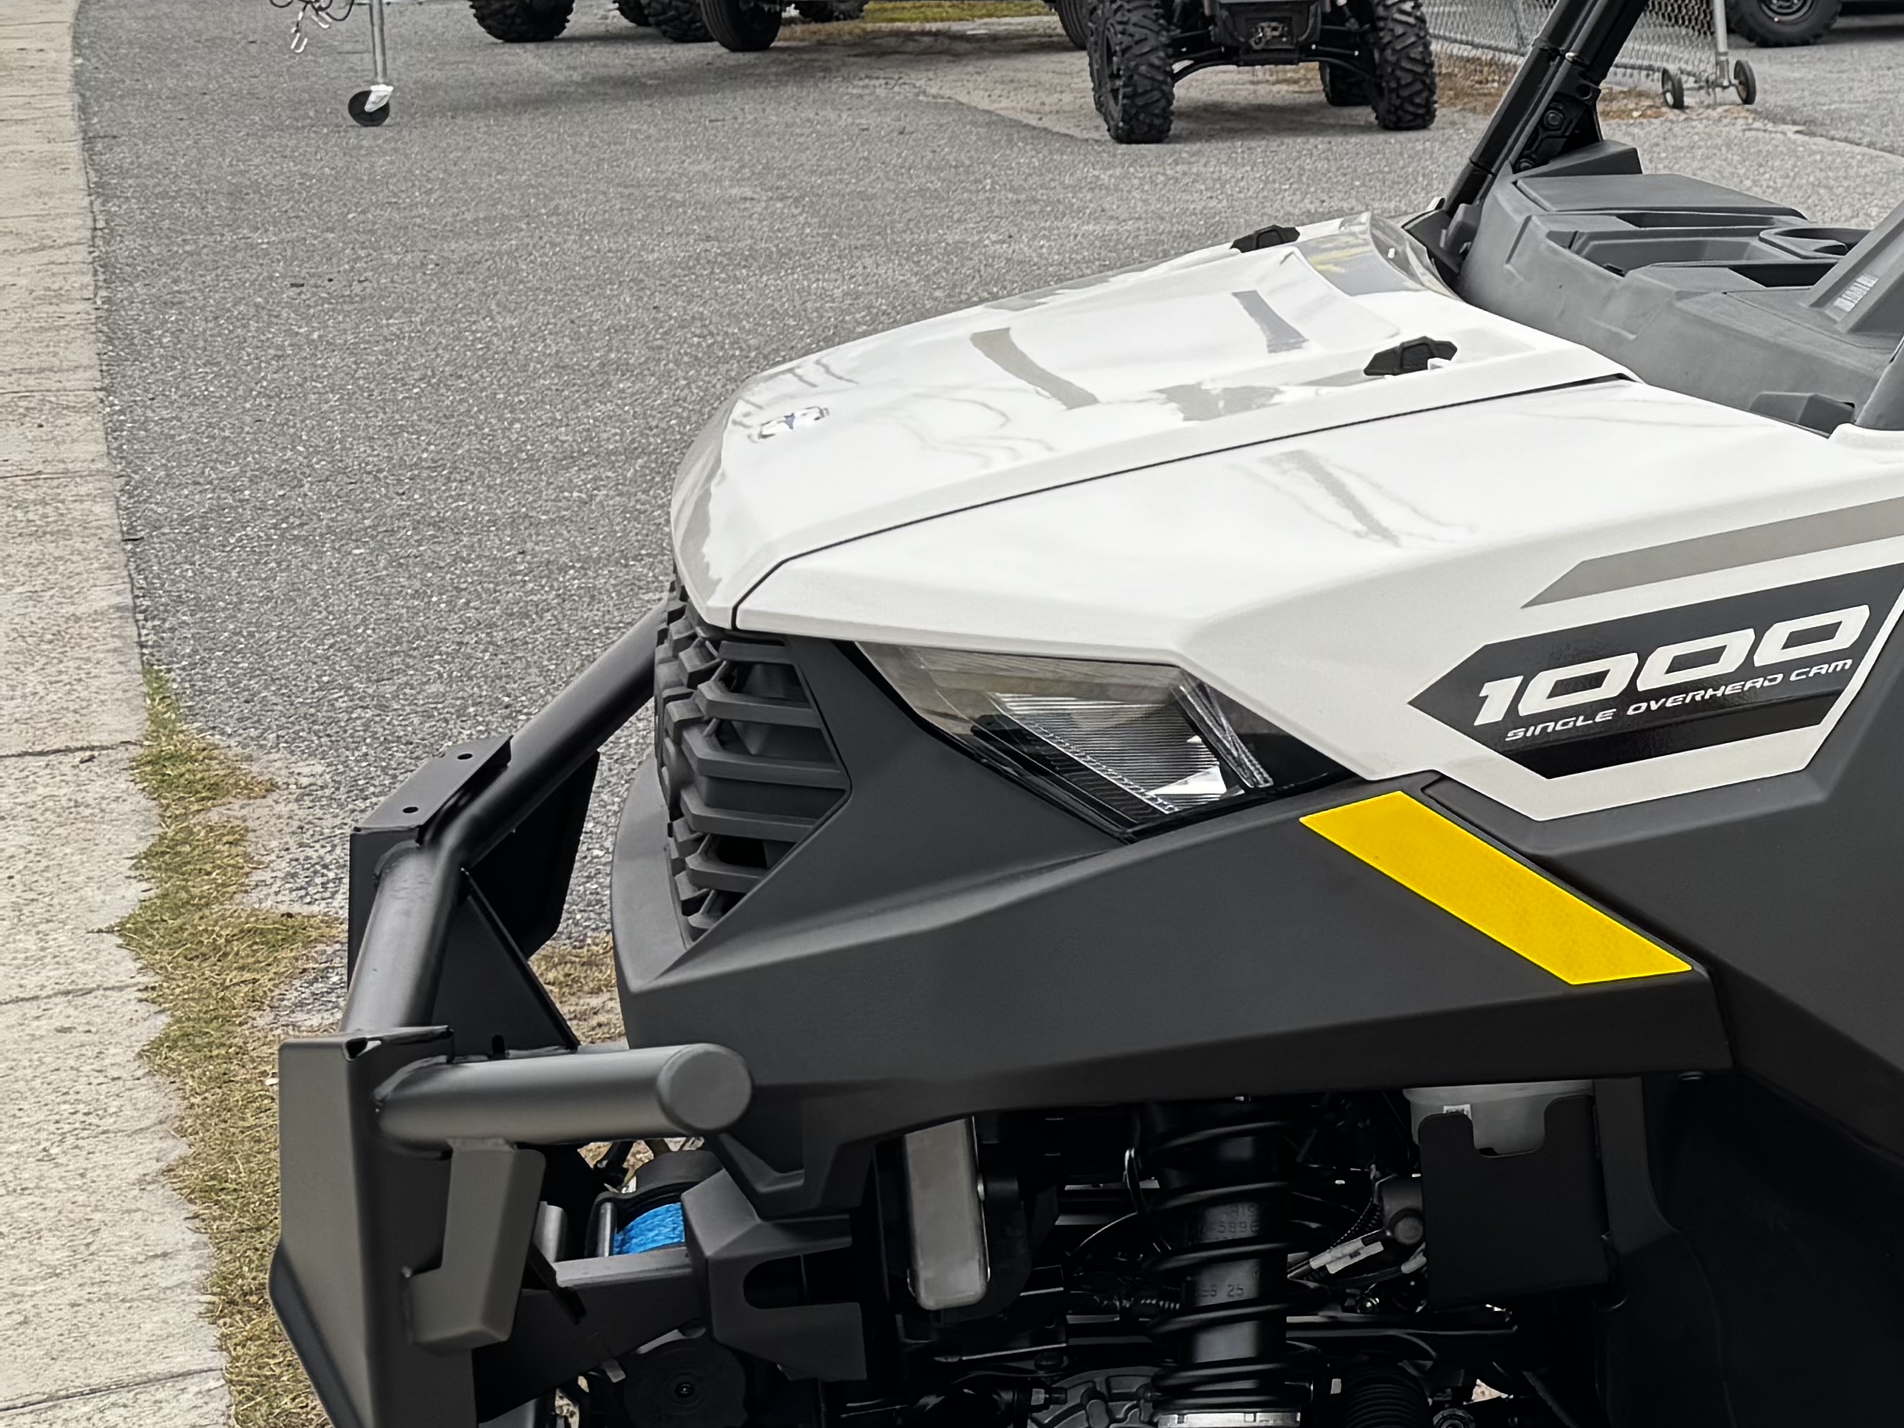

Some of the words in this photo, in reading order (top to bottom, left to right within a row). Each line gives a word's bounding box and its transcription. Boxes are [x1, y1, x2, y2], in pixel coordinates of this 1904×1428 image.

[1473, 605, 1871, 727] 1000
[1506, 710, 1614, 742] SINGLE
[1627, 674, 1783, 716] OVERHEAD
[1789, 658, 1854, 683] CAM
